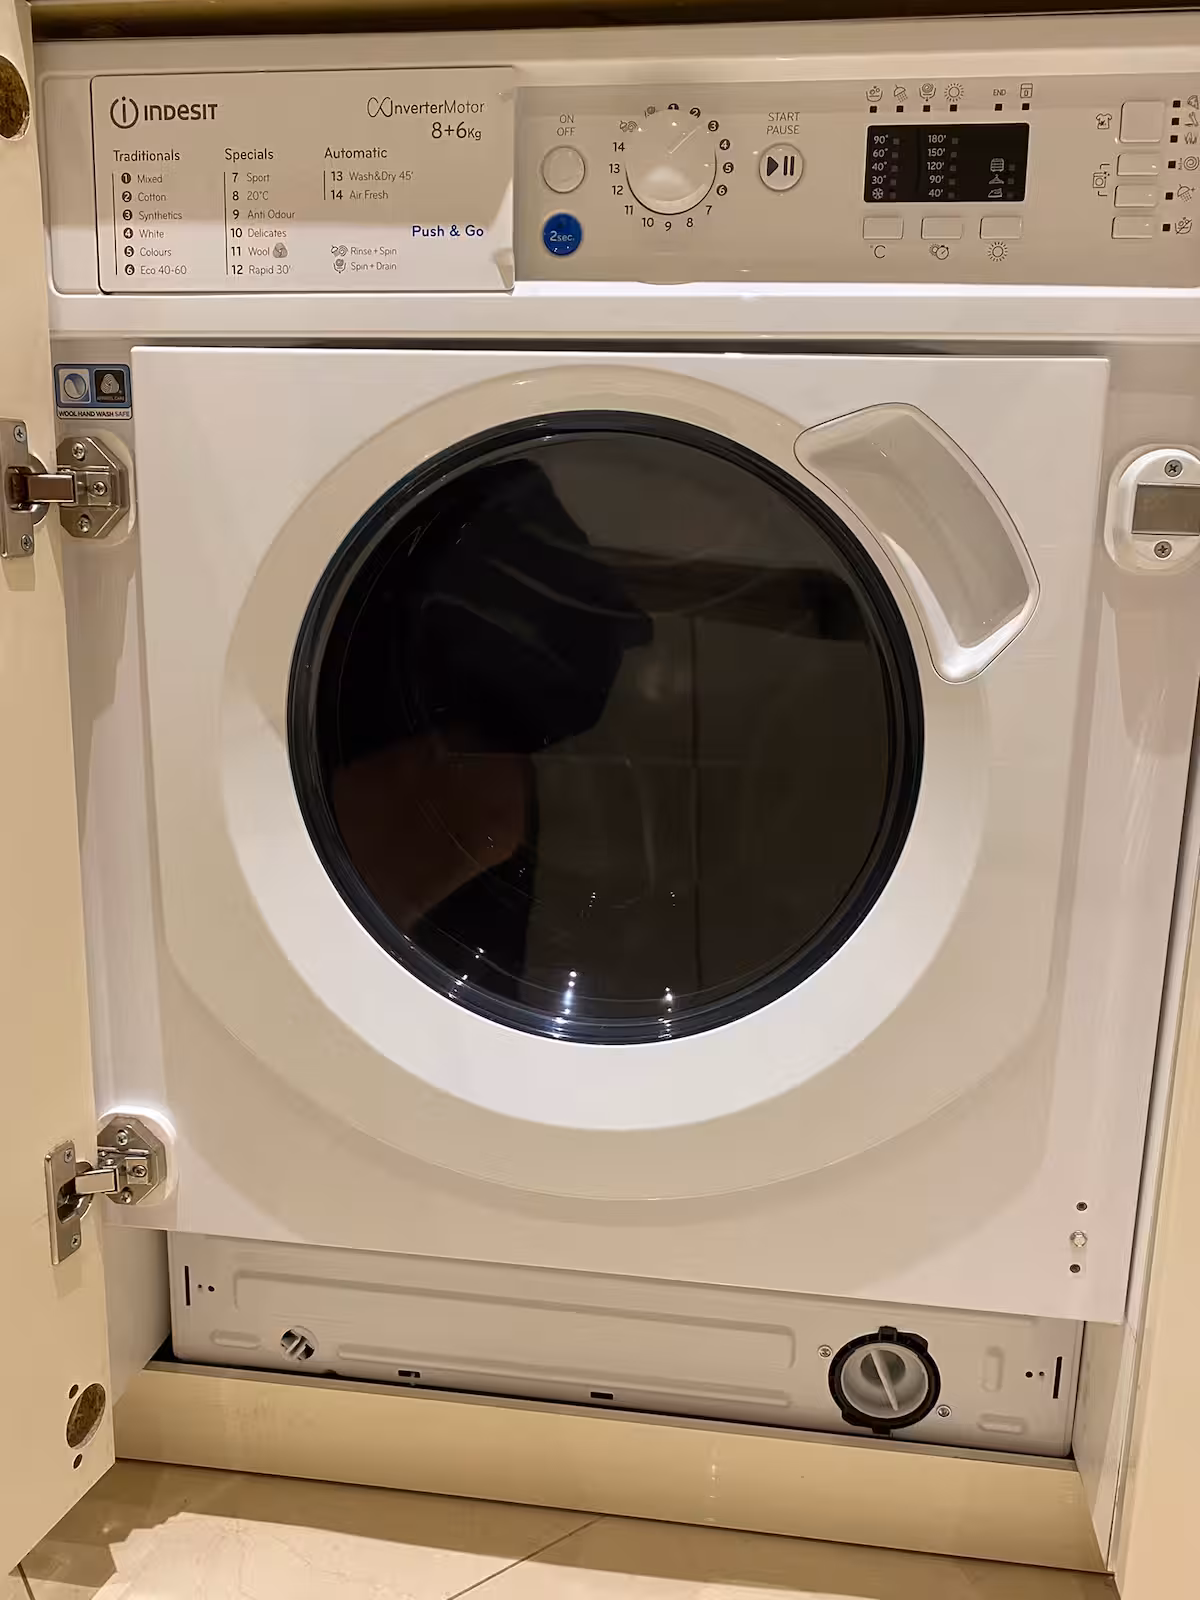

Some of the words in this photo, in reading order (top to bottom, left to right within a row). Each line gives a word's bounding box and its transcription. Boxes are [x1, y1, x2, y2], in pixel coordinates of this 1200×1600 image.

[559, 114, 574, 124] ON
[768, 112, 800, 122] START
[431, 121, 482, 141] 8+6Kg
[556, 127, 575, 136] OFF
[766, 125, 800, 135] PAUSE
[613, 142, 625, 152] 14
[113, 149, 180, 161] Traditionals
[224, 148, 274, 163] Specials
[324, 147, 388, 159] Automatic
[609, 164, 620, 174] 13
[137, 174, 163, 183] Mixed
[232, 172, 239, 183] 7
[247, 173, 270, 184] Sport
[331, 171, 343, 181] 13
[349, 171, 396, 182] Wash&Dry
[331, 190, 343, 200] 14
[350, 190, 363, 199] Air
[364, 190, 388, 199] Fresh
[612, 186, 623, 195] 12
[138, 192, 166, 201] Cotton
[232, 191, 239, 201] 8
[233, 209, 240, 219] 9
[247, 210, 265, 219] Anti
[268, 210, 295, 219] Odour
[624, 206, 634, 215] 11
[706, 205, 712, 215] 7
[139, 211, 183, 221] Synthetics
[642, 218, 654, 228] 10
[664, 221, 672, 231] 9
[686, 218, 694, 228] 8
[139, 230, 164, 238] White
[231, 228, 243, 238] 10
[248, 229, 287, 238] Delicates
[412, 225, 445, 237] Push
[450, 225, 461, 237] &
[465, 225, 484, 237] Go
[140, 247, 172, 257] Colours
[231, 247, 241, 256] 11
[248, 247, 270, 256] Wool
[351, 247, 372, 255] Rinse
[380, 247, 397, 257] Spin
[140, 266, 156, 275] Eco
[158, 266, 187, 274] 40-60
[232, 265, 243, 275] 12
[249, 265, 274, 276] Rapid
[351, 262, 368, 272] Spin
[376, 262, 396, 270] Drain
